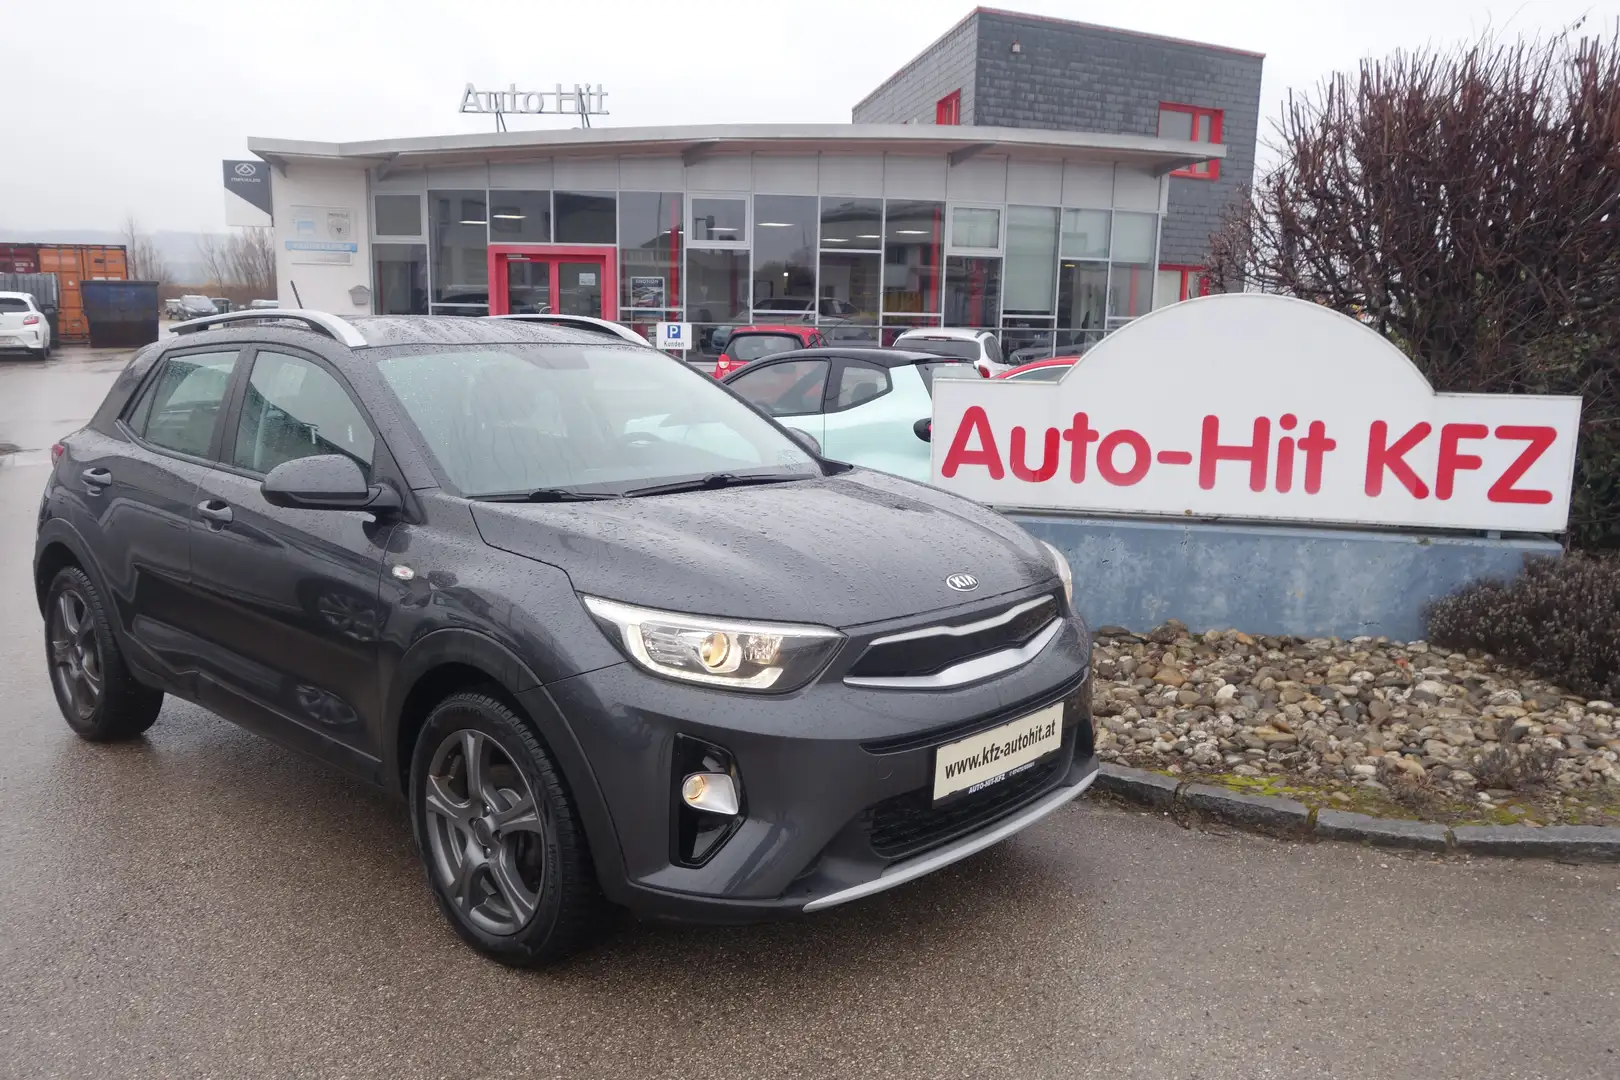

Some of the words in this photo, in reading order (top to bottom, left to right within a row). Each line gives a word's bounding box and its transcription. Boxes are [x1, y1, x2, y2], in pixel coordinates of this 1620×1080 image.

[459, 82, 545, 114] Auto
[555, 82, 609, 114] Hit
[664, 340, 685, 348] Kunden
[669, 325, 679, 338] P
[941, 404, 1337, 496] Auto-Hit
[1364, 418, 1558, 505] KFZ
[945, 718, 1056, 780] www.kfz-autohit.at
